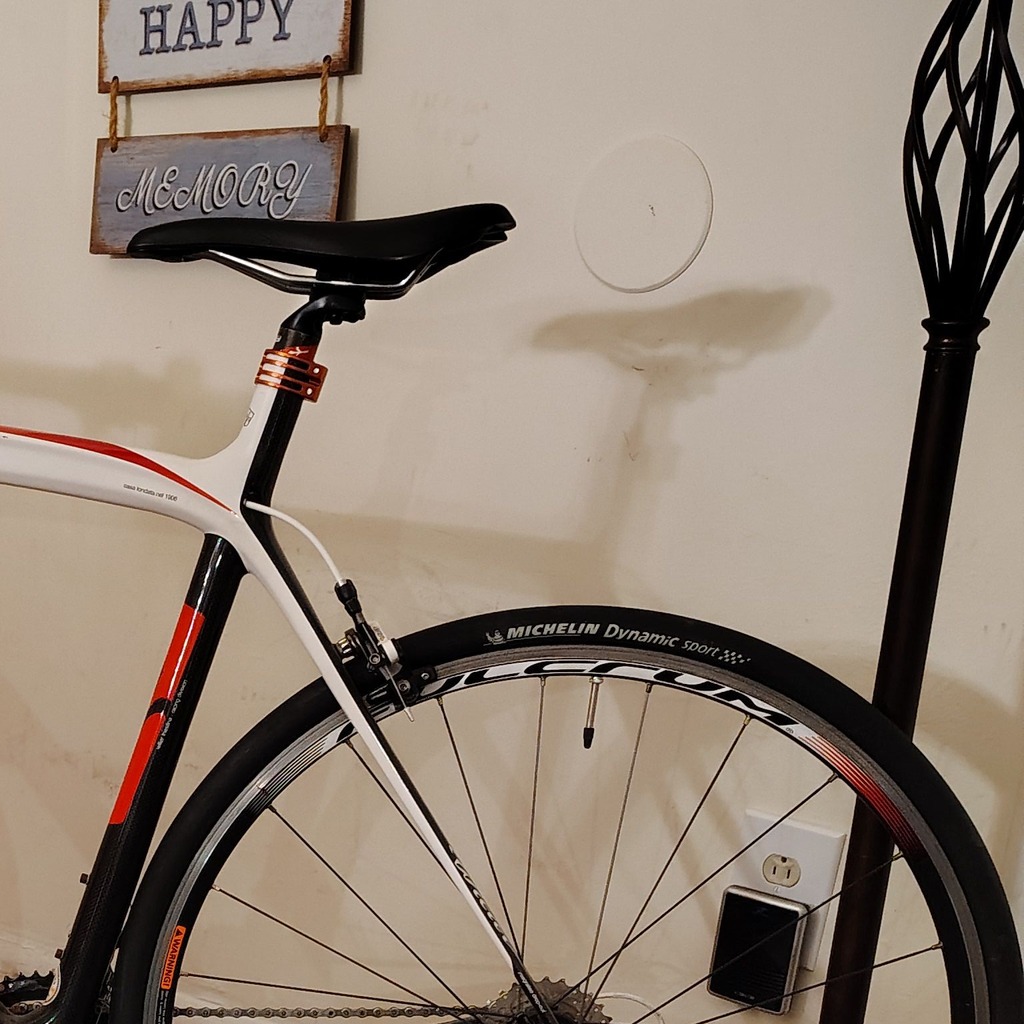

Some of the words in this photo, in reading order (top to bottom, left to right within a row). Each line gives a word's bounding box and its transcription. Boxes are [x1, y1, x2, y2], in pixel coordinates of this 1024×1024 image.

[139, 0, 293, 56] HAPPY
[116, 160, 314, 220] MEMORY
[507, 622, 601, 640] MICHELIN
[603, 623, 679, 648] Dynamic
[681, 639, 720, 657] sport
[163, 938, 182, 988] WARNING!
